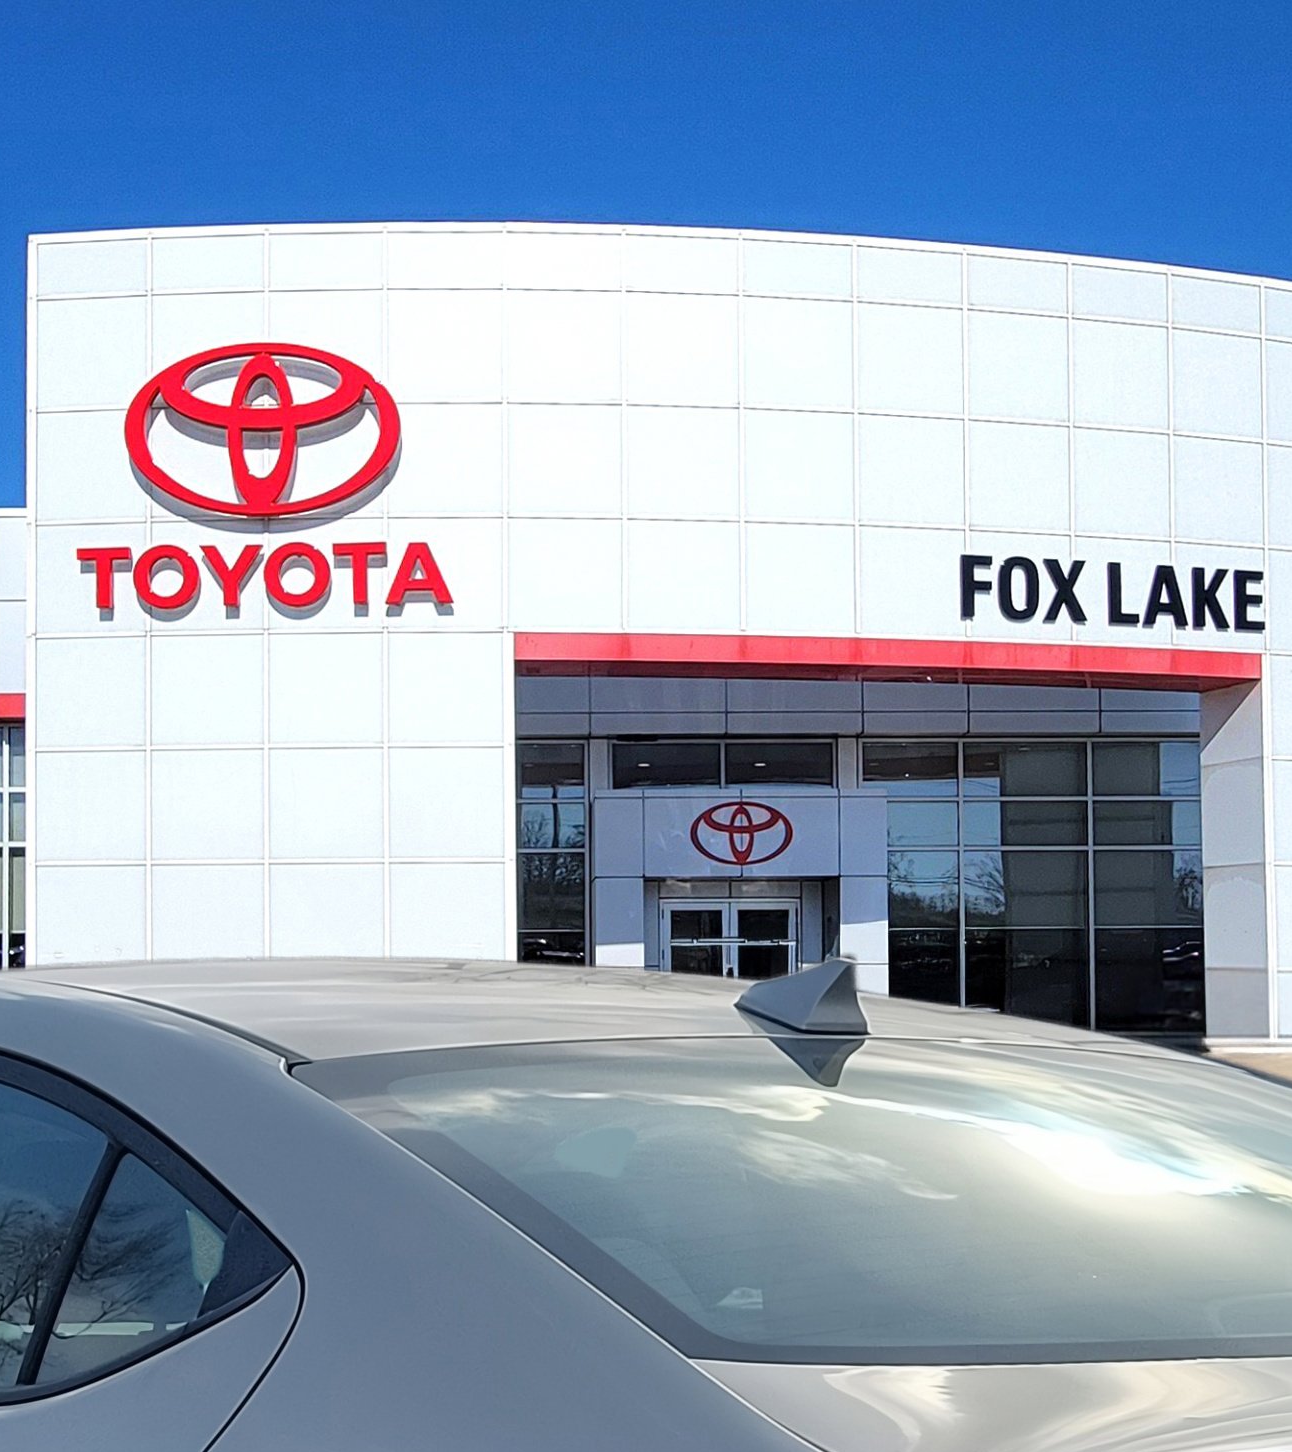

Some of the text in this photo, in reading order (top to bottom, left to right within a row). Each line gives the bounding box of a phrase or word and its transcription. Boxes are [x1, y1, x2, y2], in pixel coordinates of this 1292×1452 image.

[76, 542, 455, 615] TOYOTA
[959, 554, 1266, 632] FOX LAKE
